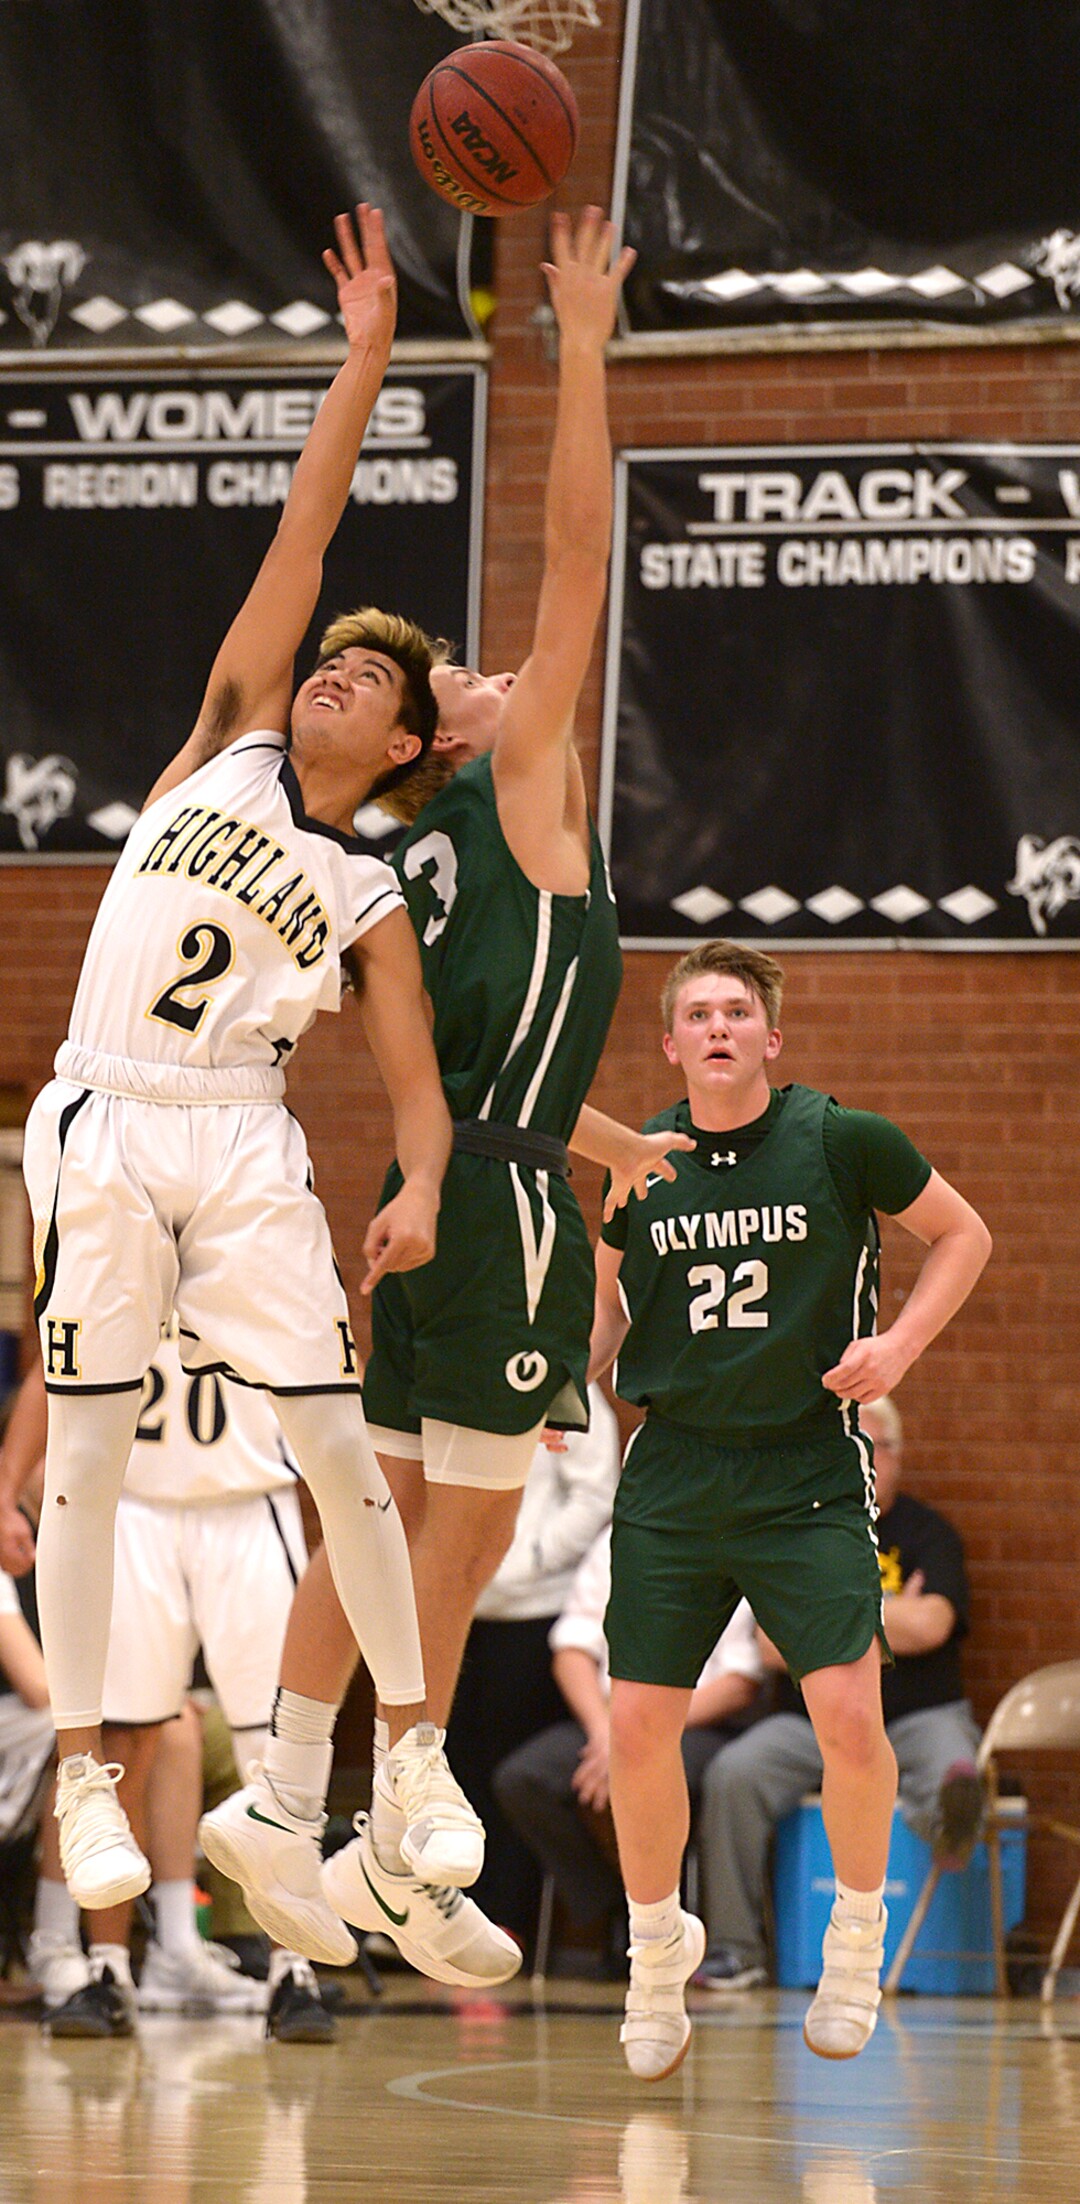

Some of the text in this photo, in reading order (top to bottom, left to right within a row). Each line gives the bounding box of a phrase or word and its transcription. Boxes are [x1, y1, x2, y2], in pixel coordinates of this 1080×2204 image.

[417, 118, 490, 213] Wilson
[451, 111, 517, 184] NCAA
[67, 387, 426, 440] WOMES
[43, 461, 199, 509] REGION
[206, 456, 459, 509] CHAIONS
[699, 469, 968, 522] TRACK
[640, 541, 767, 589] STATE
[777, 537, 1038, 585] CHAMPIONS
[134, 804, 332, 971] HIGHLAND
[144, 917, 237, 1038] 2
[649, 1203, 808, 1256] OLYMPUS
[686, 1258, 769, 1335] 22
[46, 1315, 82, 1380] H
[134, 1364, 229, 1446] 20
